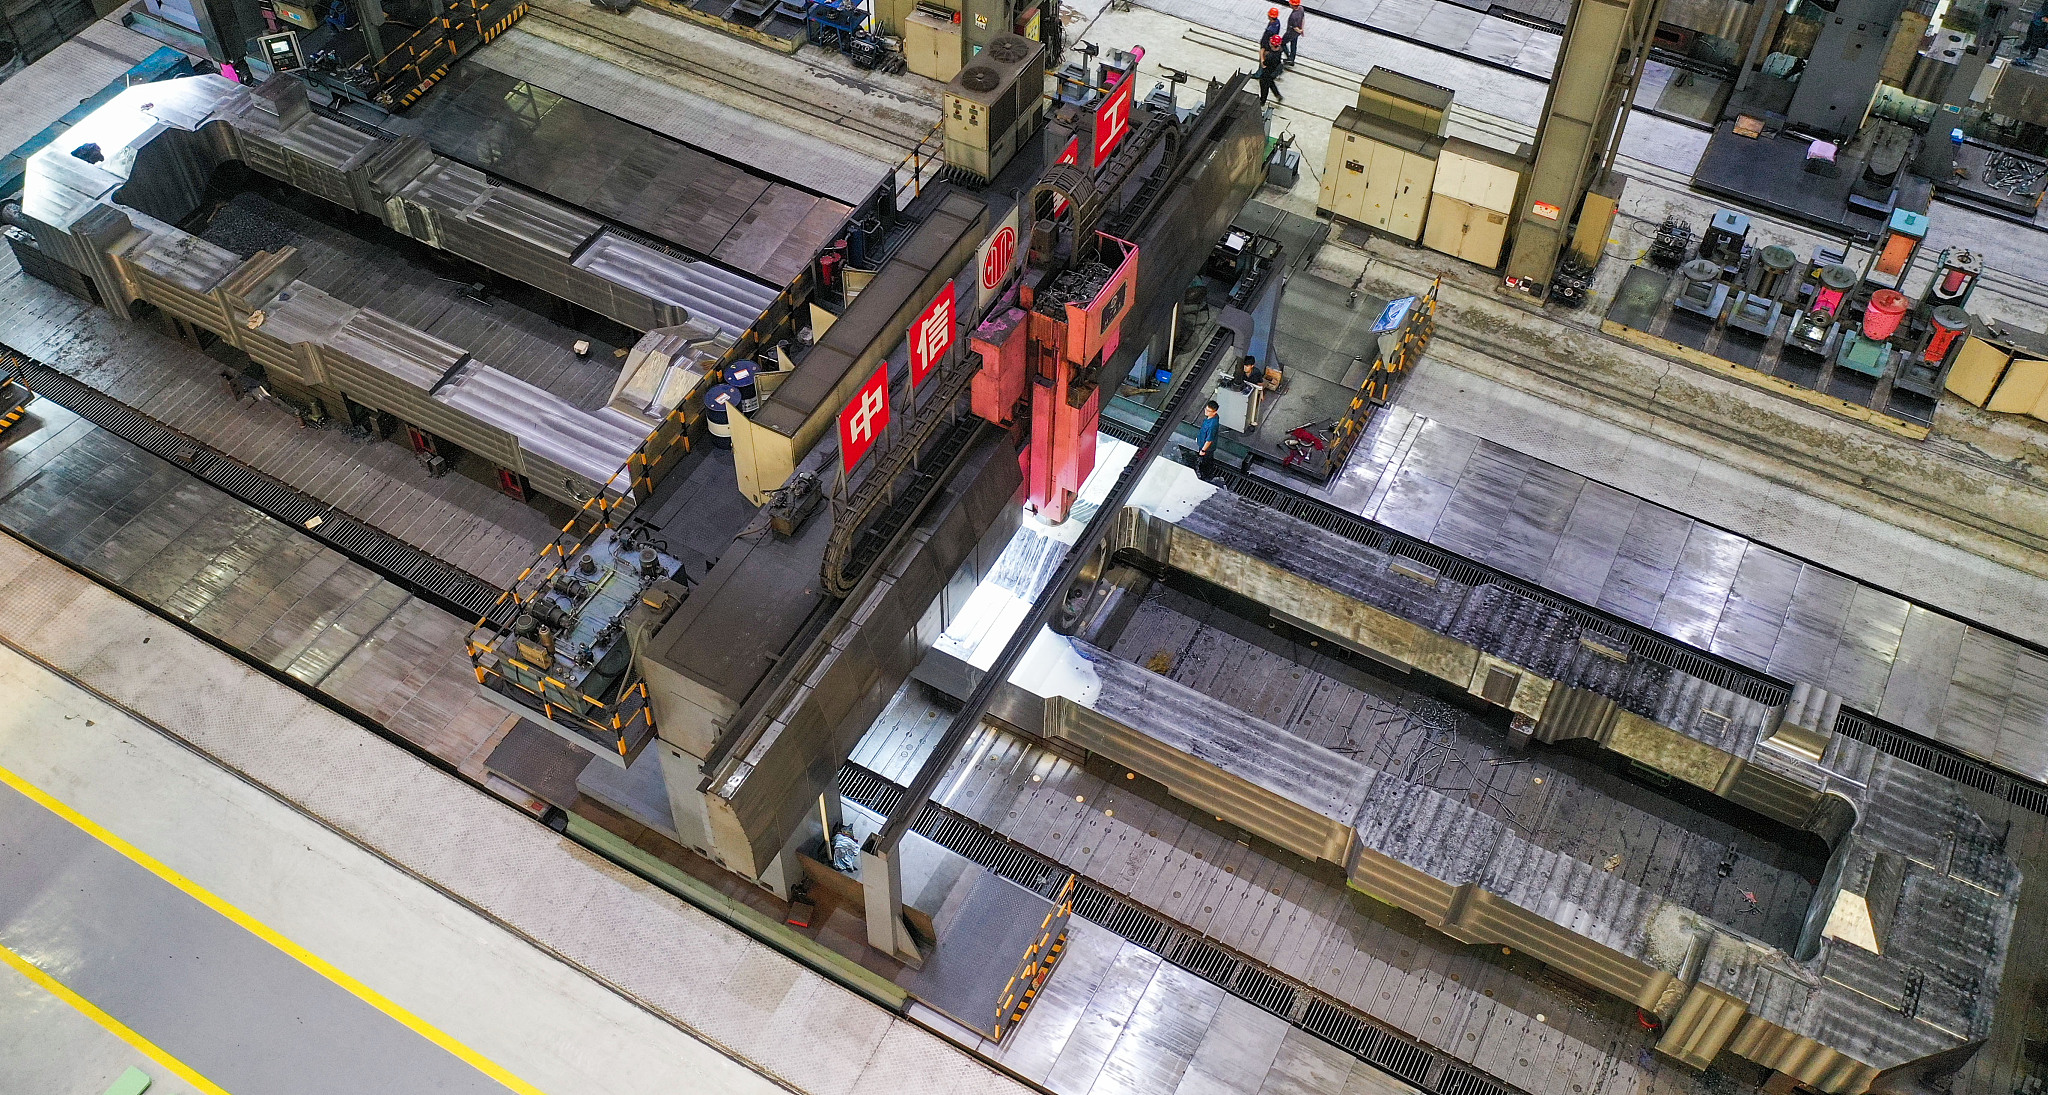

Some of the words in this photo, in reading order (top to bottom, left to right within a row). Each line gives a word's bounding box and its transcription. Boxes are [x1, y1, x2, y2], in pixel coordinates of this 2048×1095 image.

[1100, 90, 1127, 153] 工
[917, 298, 950, 371] 信
[850, 385, 883, 444] 中
